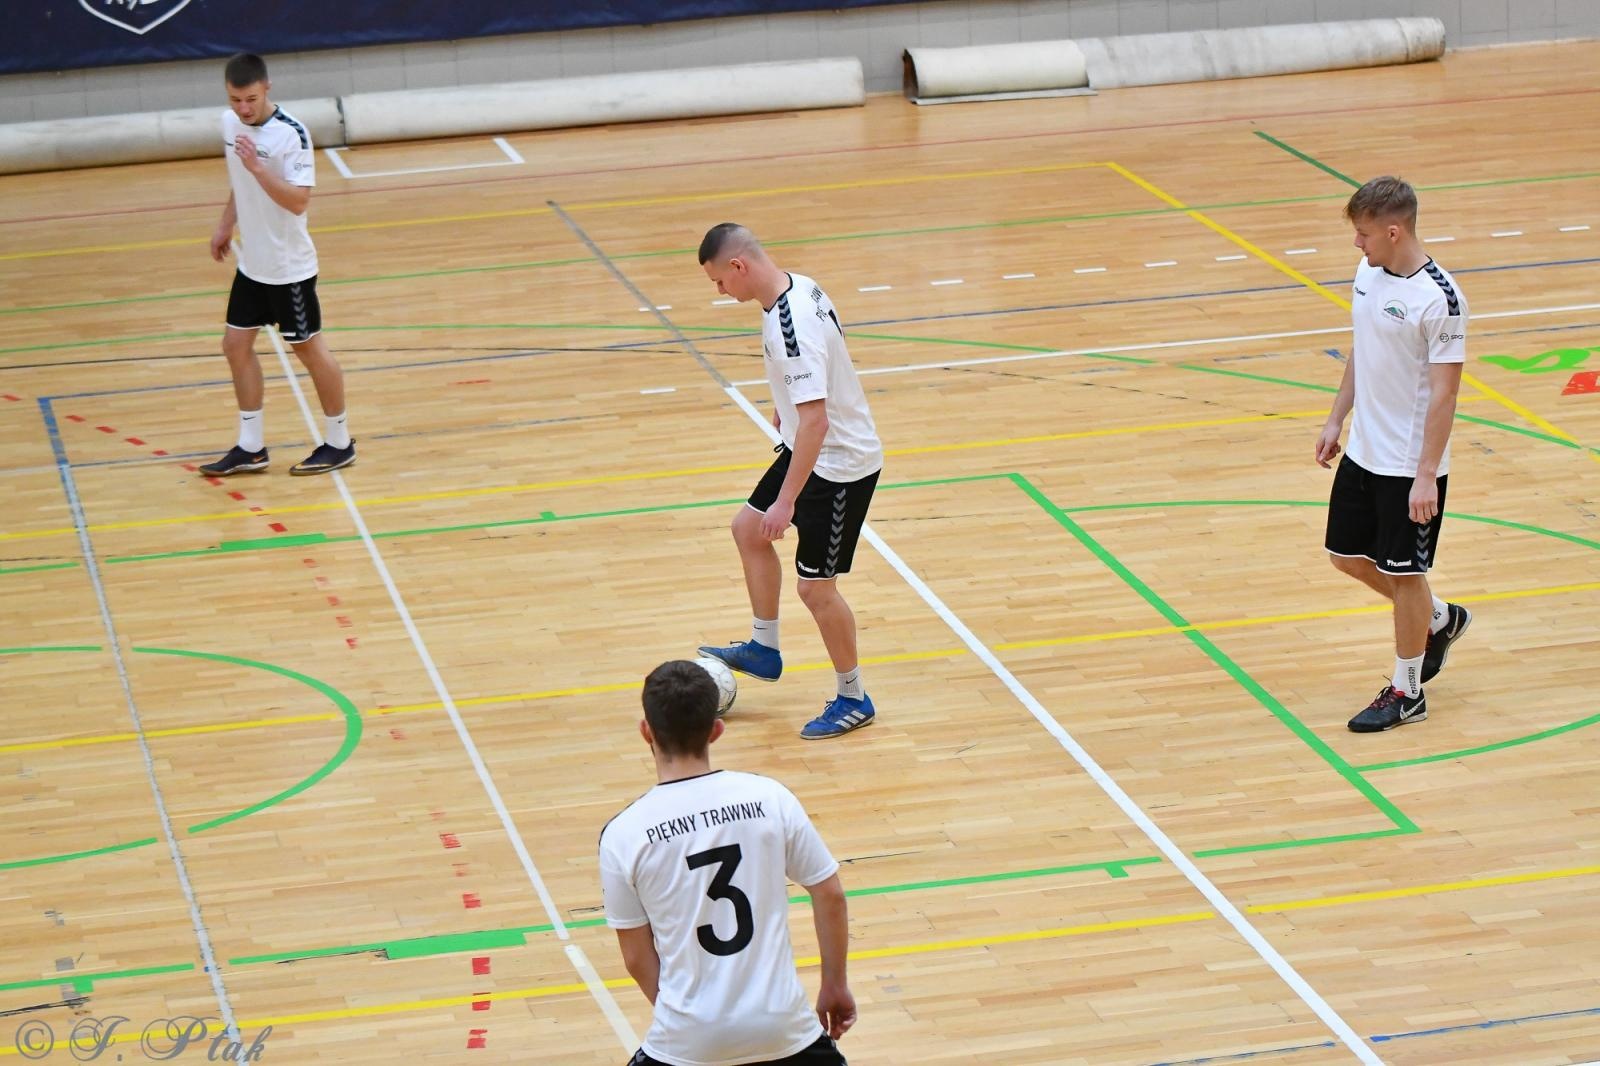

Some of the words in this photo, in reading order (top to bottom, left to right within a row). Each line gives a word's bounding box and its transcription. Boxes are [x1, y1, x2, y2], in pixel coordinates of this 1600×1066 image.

[793, 372, 812, 382] SPORT
[645, 814, 697, 844] PIĘKNY
[700, 801, 766, 829] TRAWNIK
[685, 843, 754, 956] 3
